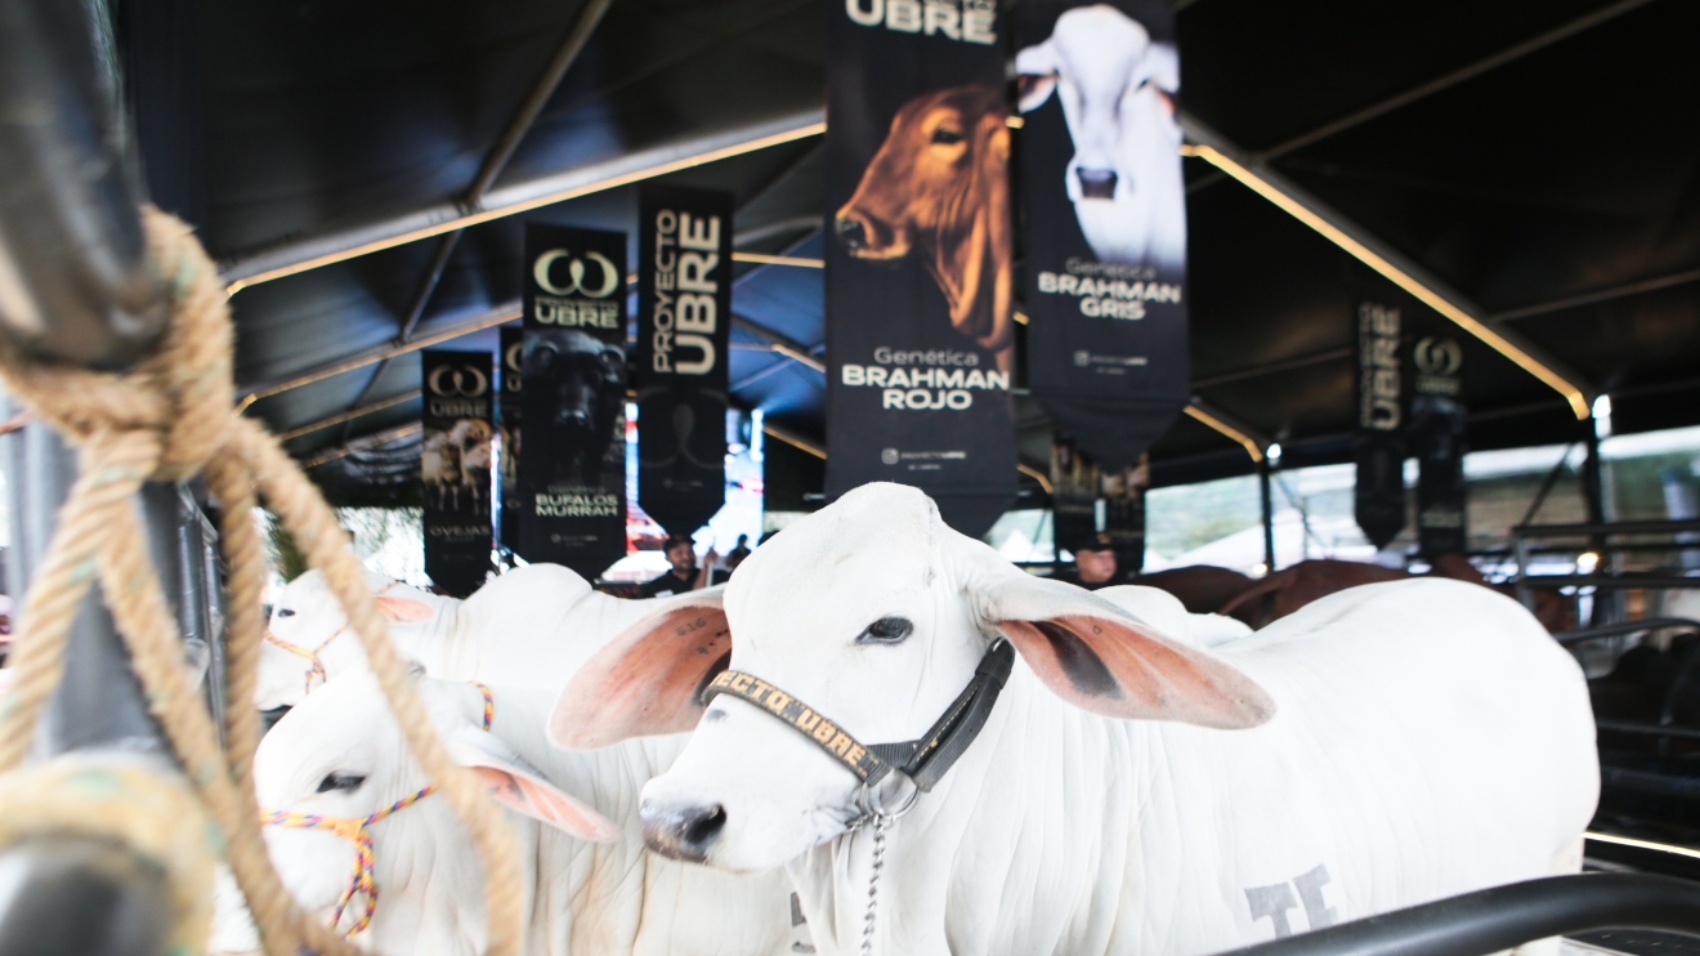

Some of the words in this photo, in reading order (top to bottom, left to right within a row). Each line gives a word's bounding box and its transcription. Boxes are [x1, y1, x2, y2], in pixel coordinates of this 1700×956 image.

[845, 0, 997, 45] UBRE
[653, 209, 677, 374] PROYECTO
[674, 212, 721, 376] UBRE
[1038, 271, 1182, 304] BRAHMAN
[534, 303, 619, 329] UBRE
[1080, 297, 1146, 320] GRIS
[874, 346, 979, 367] Genética
[1371, 305, 1401, 431] UBRE
[842, 364, 1010, 391] BRAHMAN
[429, 400, 488, 417] UBRE
[882, 390, 973, 411] ROJO
[535, 493, 619, 507] BUFALOS
[535, 505, 619, 517] MURRAH
